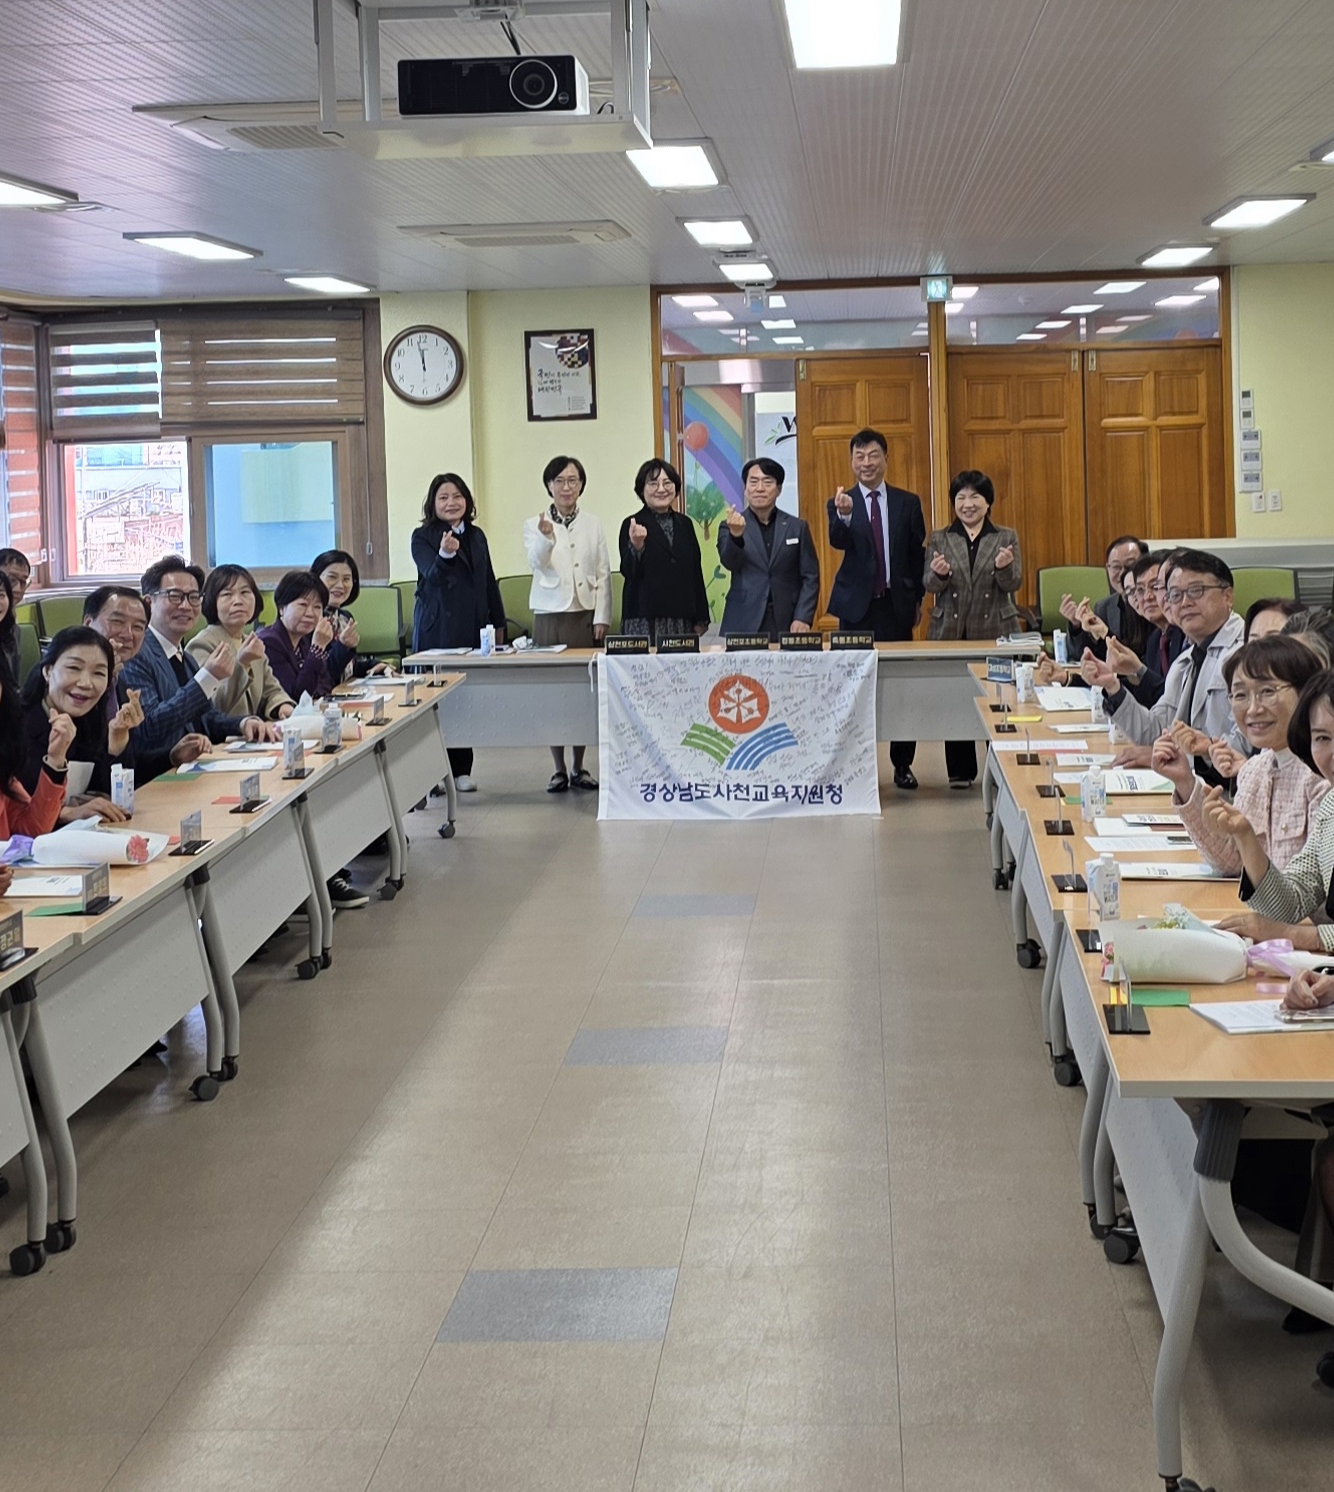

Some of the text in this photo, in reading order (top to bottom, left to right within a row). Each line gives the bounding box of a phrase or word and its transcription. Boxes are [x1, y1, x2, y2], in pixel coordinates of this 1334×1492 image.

[407, 337, 413, 347] 11
[418, 334, 428, 344] 12
[397, 348, 406, 358] 10
[443, 346, 449, 356] 2
[394, 361, 401, 371] 9
[447, 359, 453, 369] 3
[639, 782, 843, 805] 경상남도사천교육지원청
